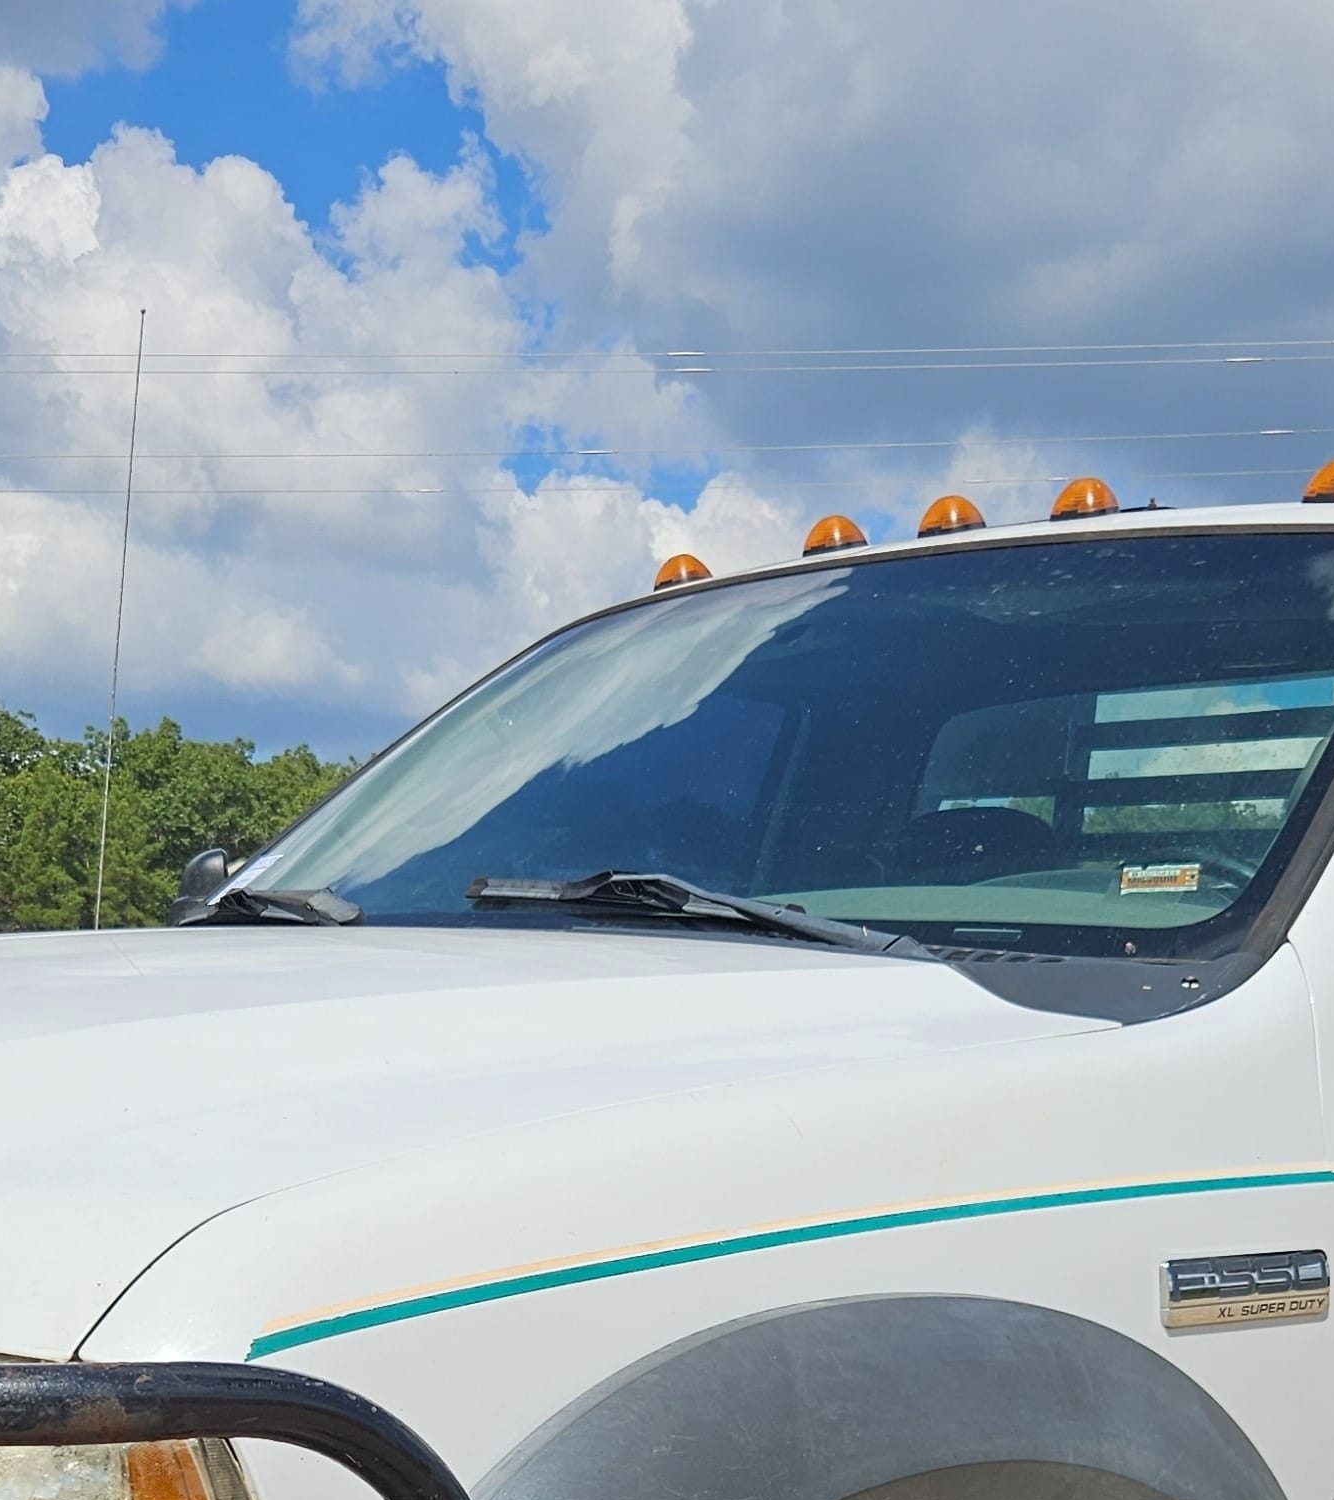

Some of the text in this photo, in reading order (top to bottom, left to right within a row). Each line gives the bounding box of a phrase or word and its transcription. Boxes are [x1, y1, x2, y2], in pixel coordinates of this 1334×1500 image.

[1217, 1298, 1326, 1319] XL SUPER DUTY
